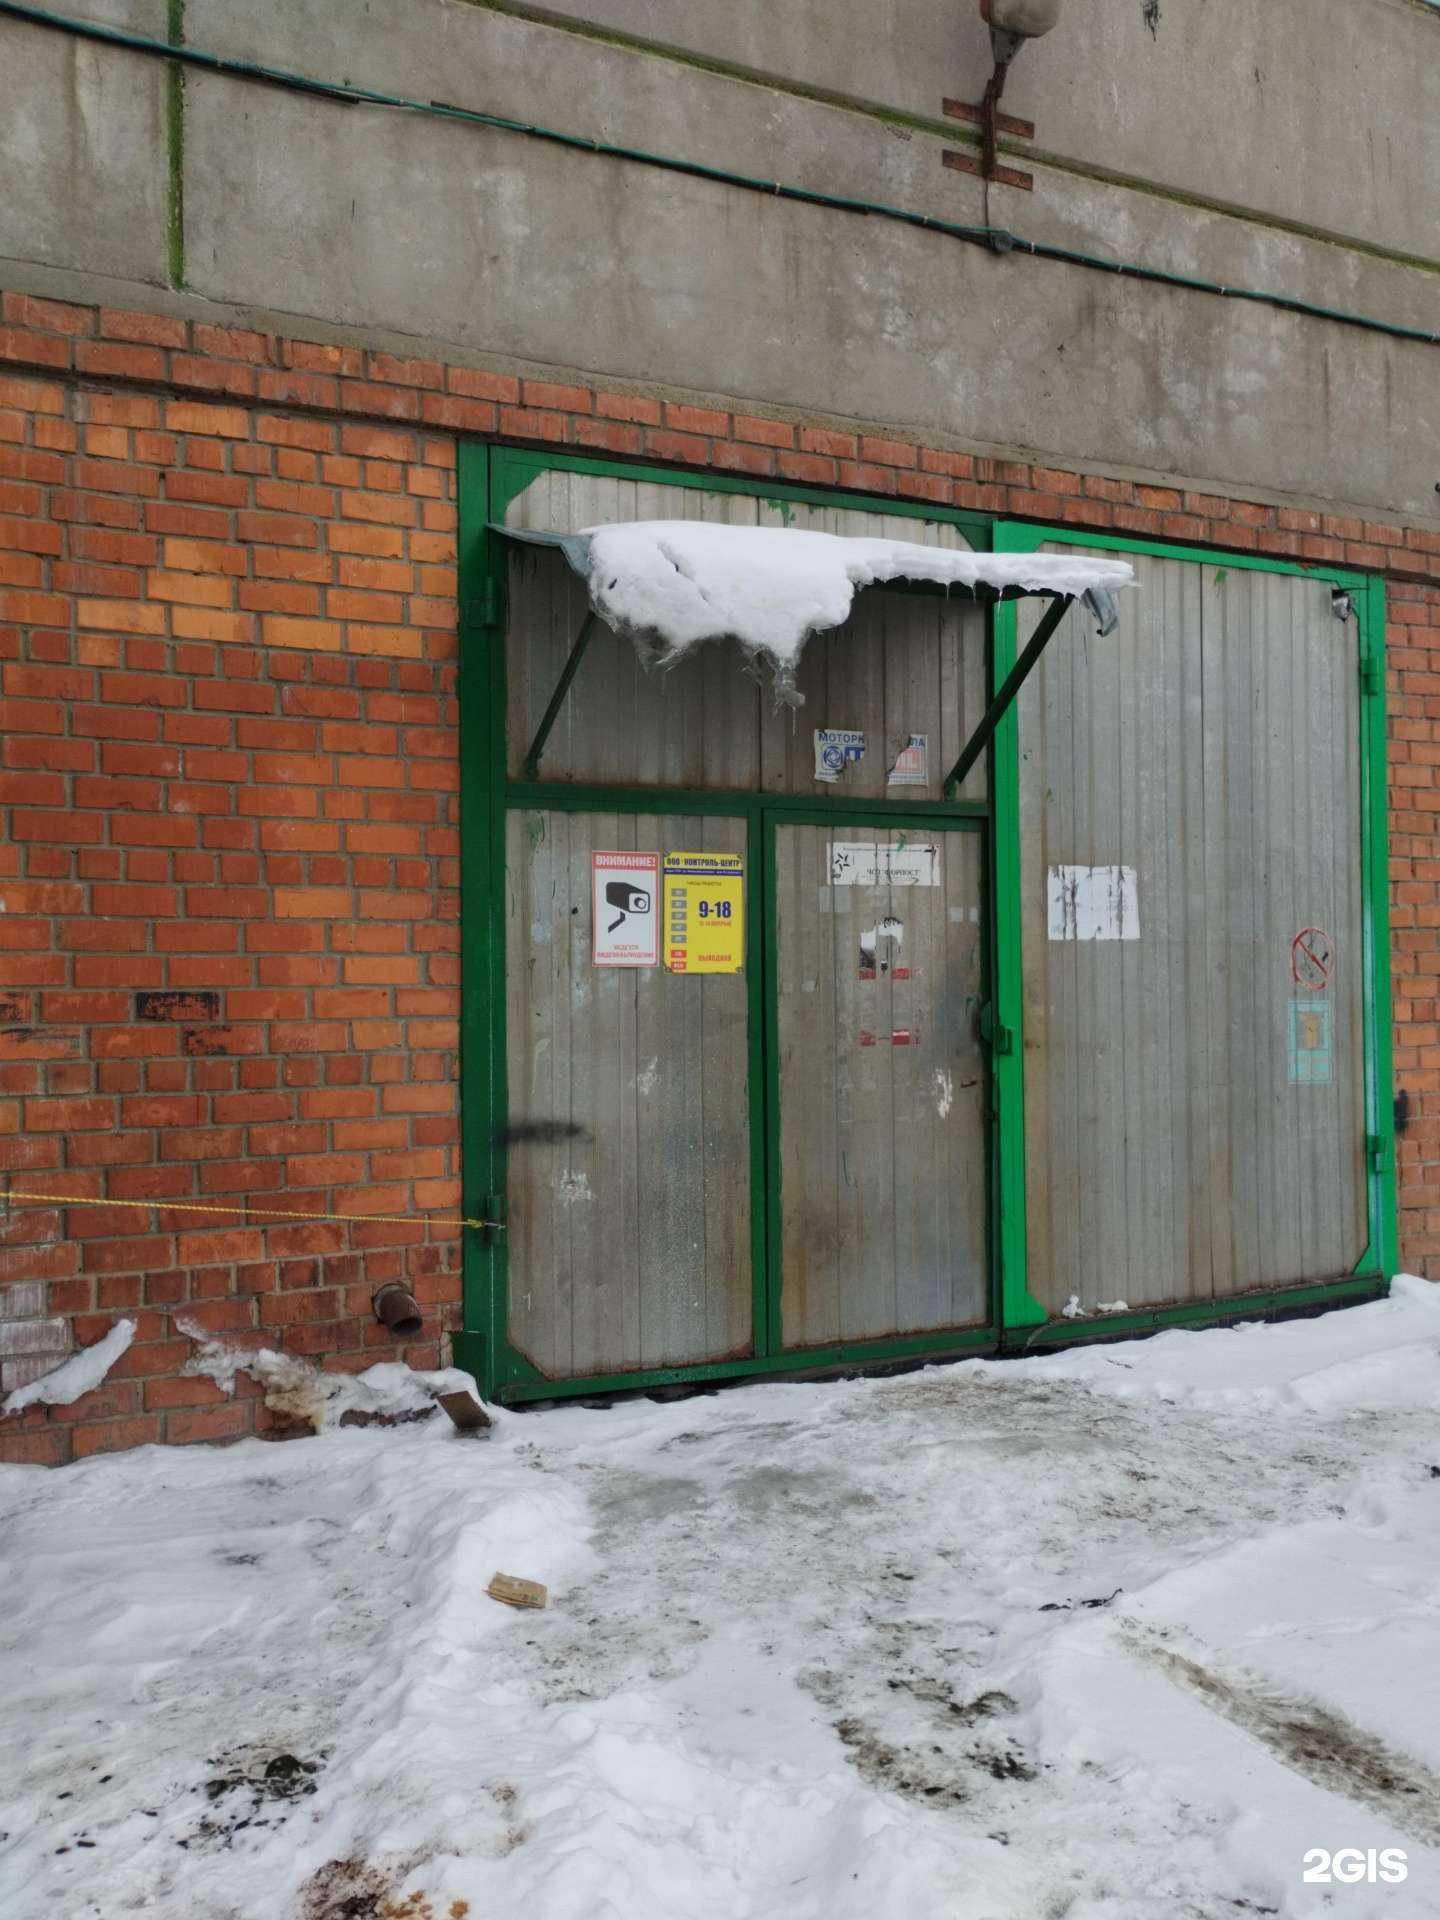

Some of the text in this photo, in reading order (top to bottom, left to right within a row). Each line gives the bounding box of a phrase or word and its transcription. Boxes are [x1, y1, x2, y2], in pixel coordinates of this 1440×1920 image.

[595, 854, 656, 867] ВНИМАНИЕ!
[667, 857, 680, 866] ООО
[698, 900, 732, 918] 9-18
